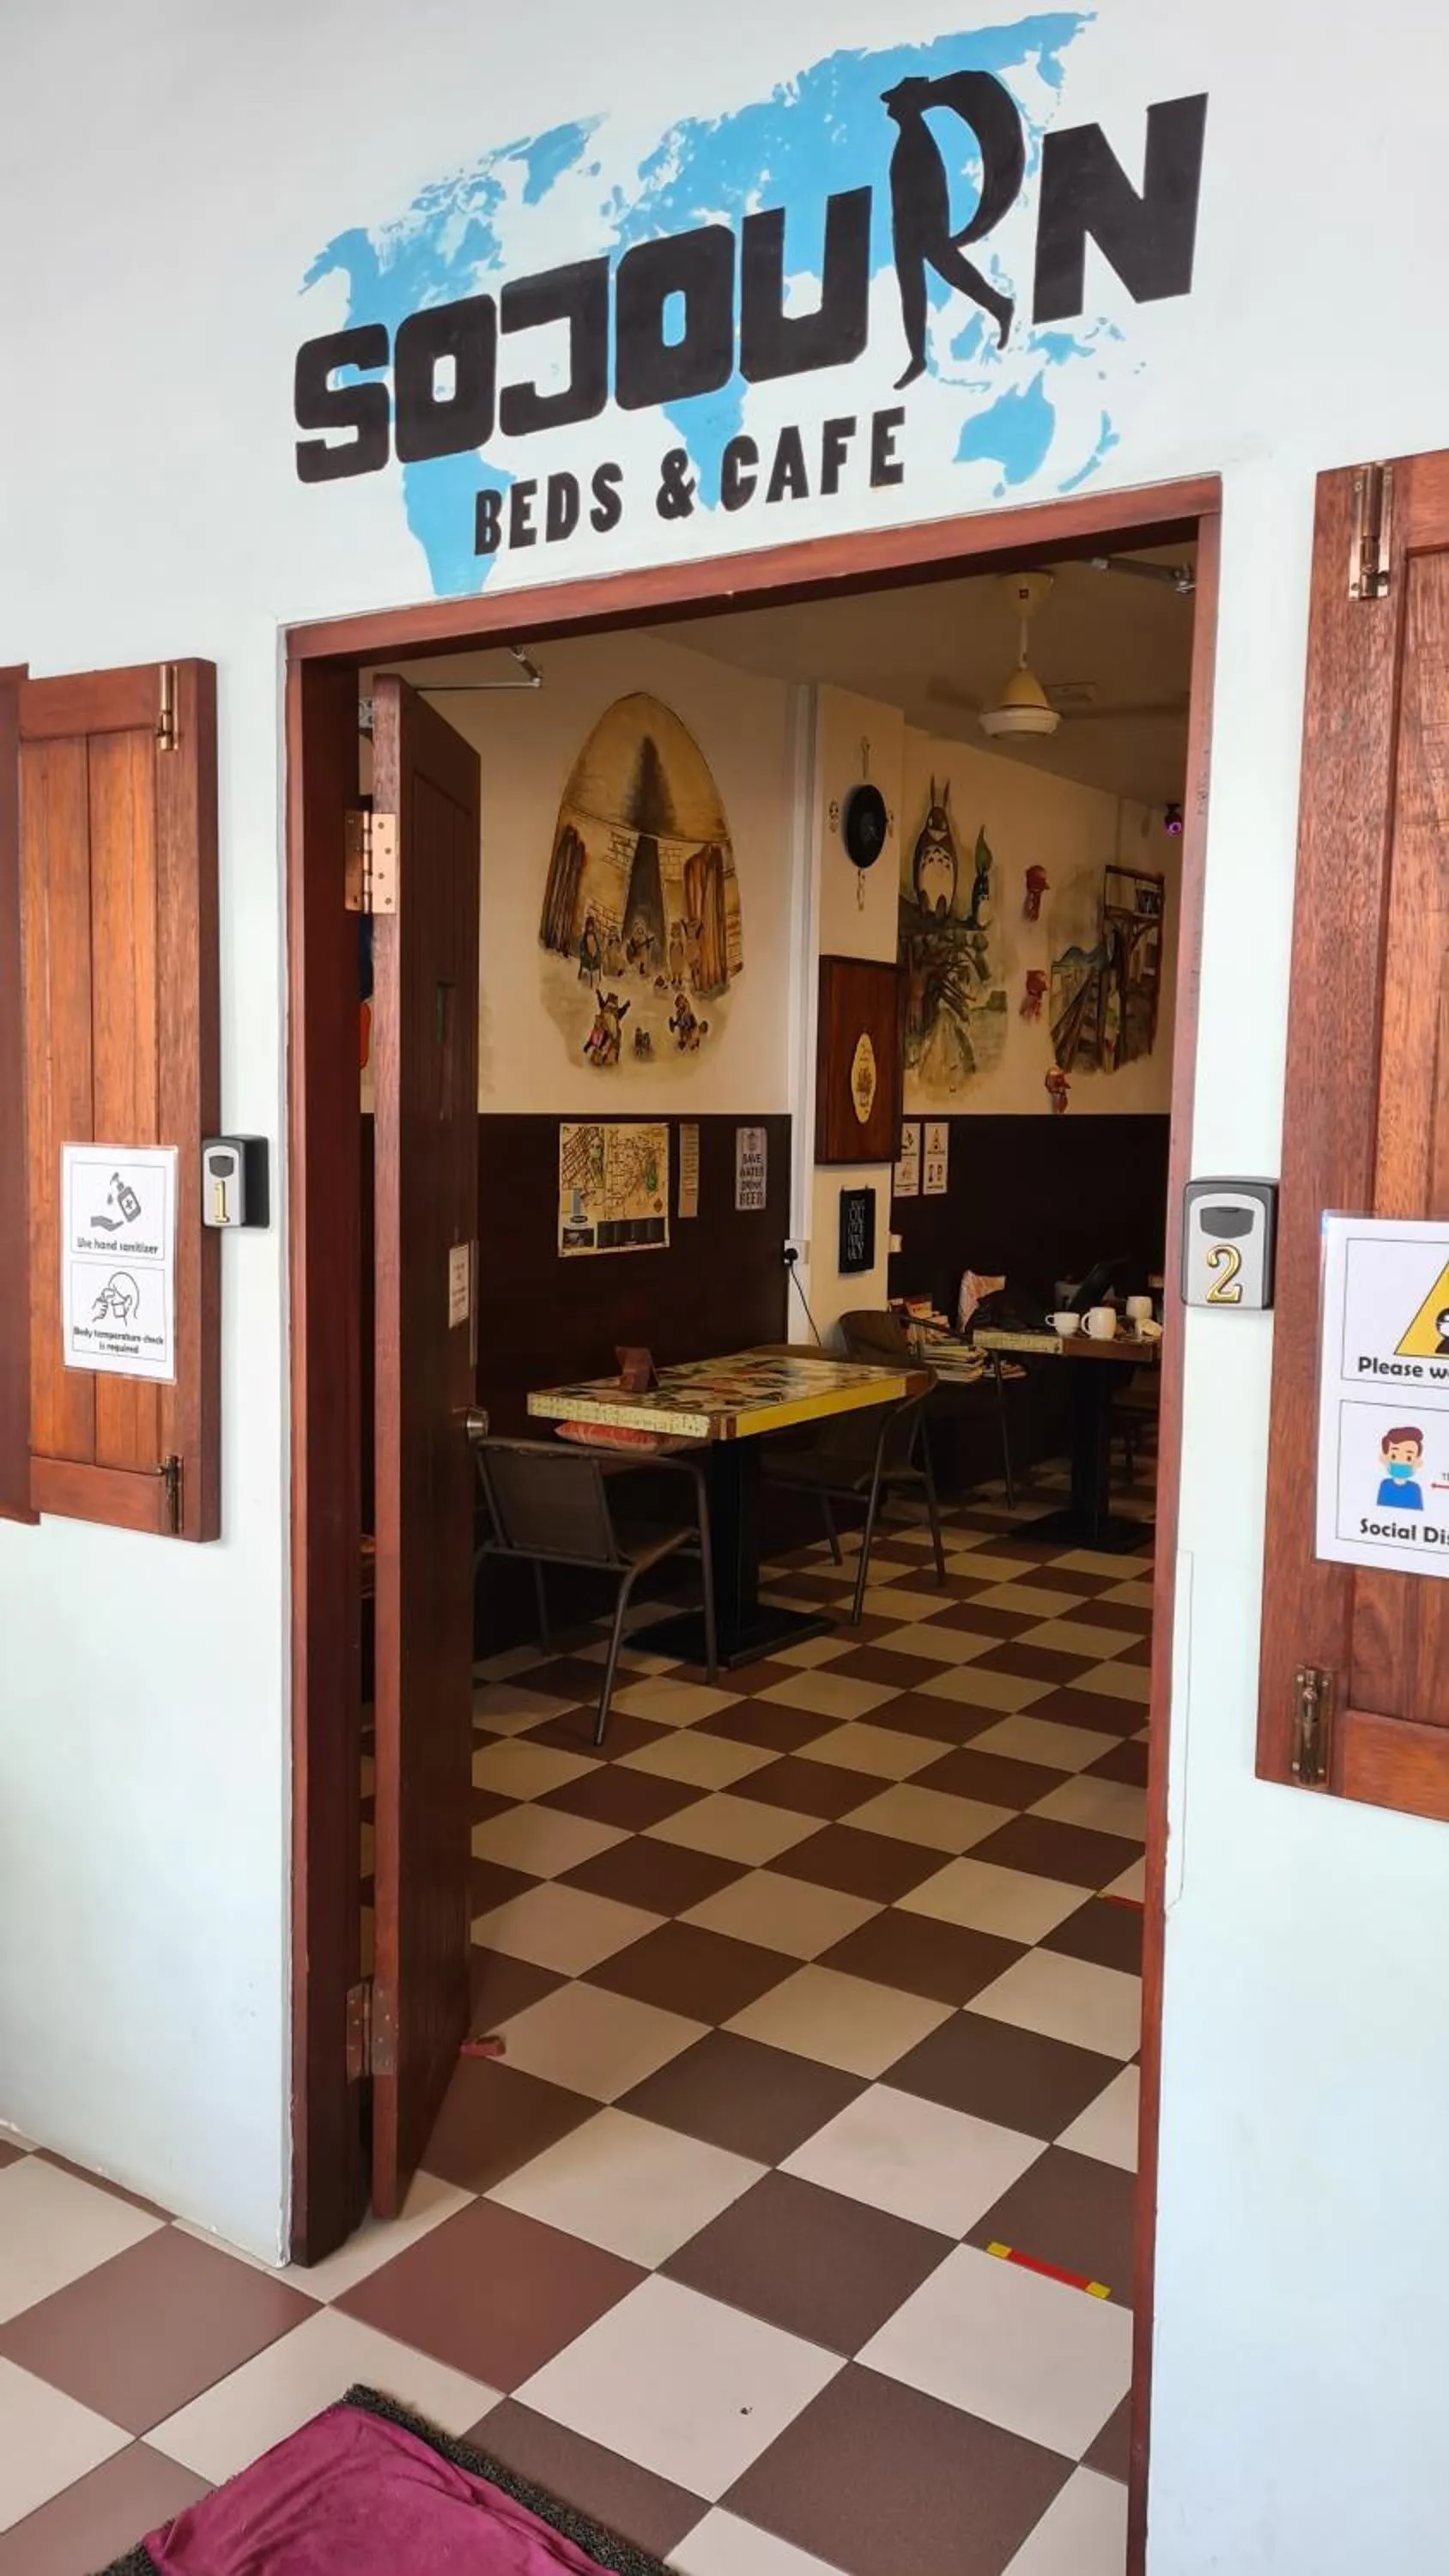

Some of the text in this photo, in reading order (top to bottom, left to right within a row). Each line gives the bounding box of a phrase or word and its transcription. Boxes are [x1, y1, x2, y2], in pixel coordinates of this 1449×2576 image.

[294, 70, 1209, 483] SOJOURN
[473, 406, 906, 556] BEDS & CAFE
[214, 1181, 230, 1224] 1
[94, 1237, 118, 1251] hand
[1205, 1243, 1242, 1304] 2
[73, 1326, 92, 1339] Body
[143, 1334, 164, 1345] check
[1358, 1356, 1449, 1380] Please w
[1360, 1518, 1449, 1546] Social Di
